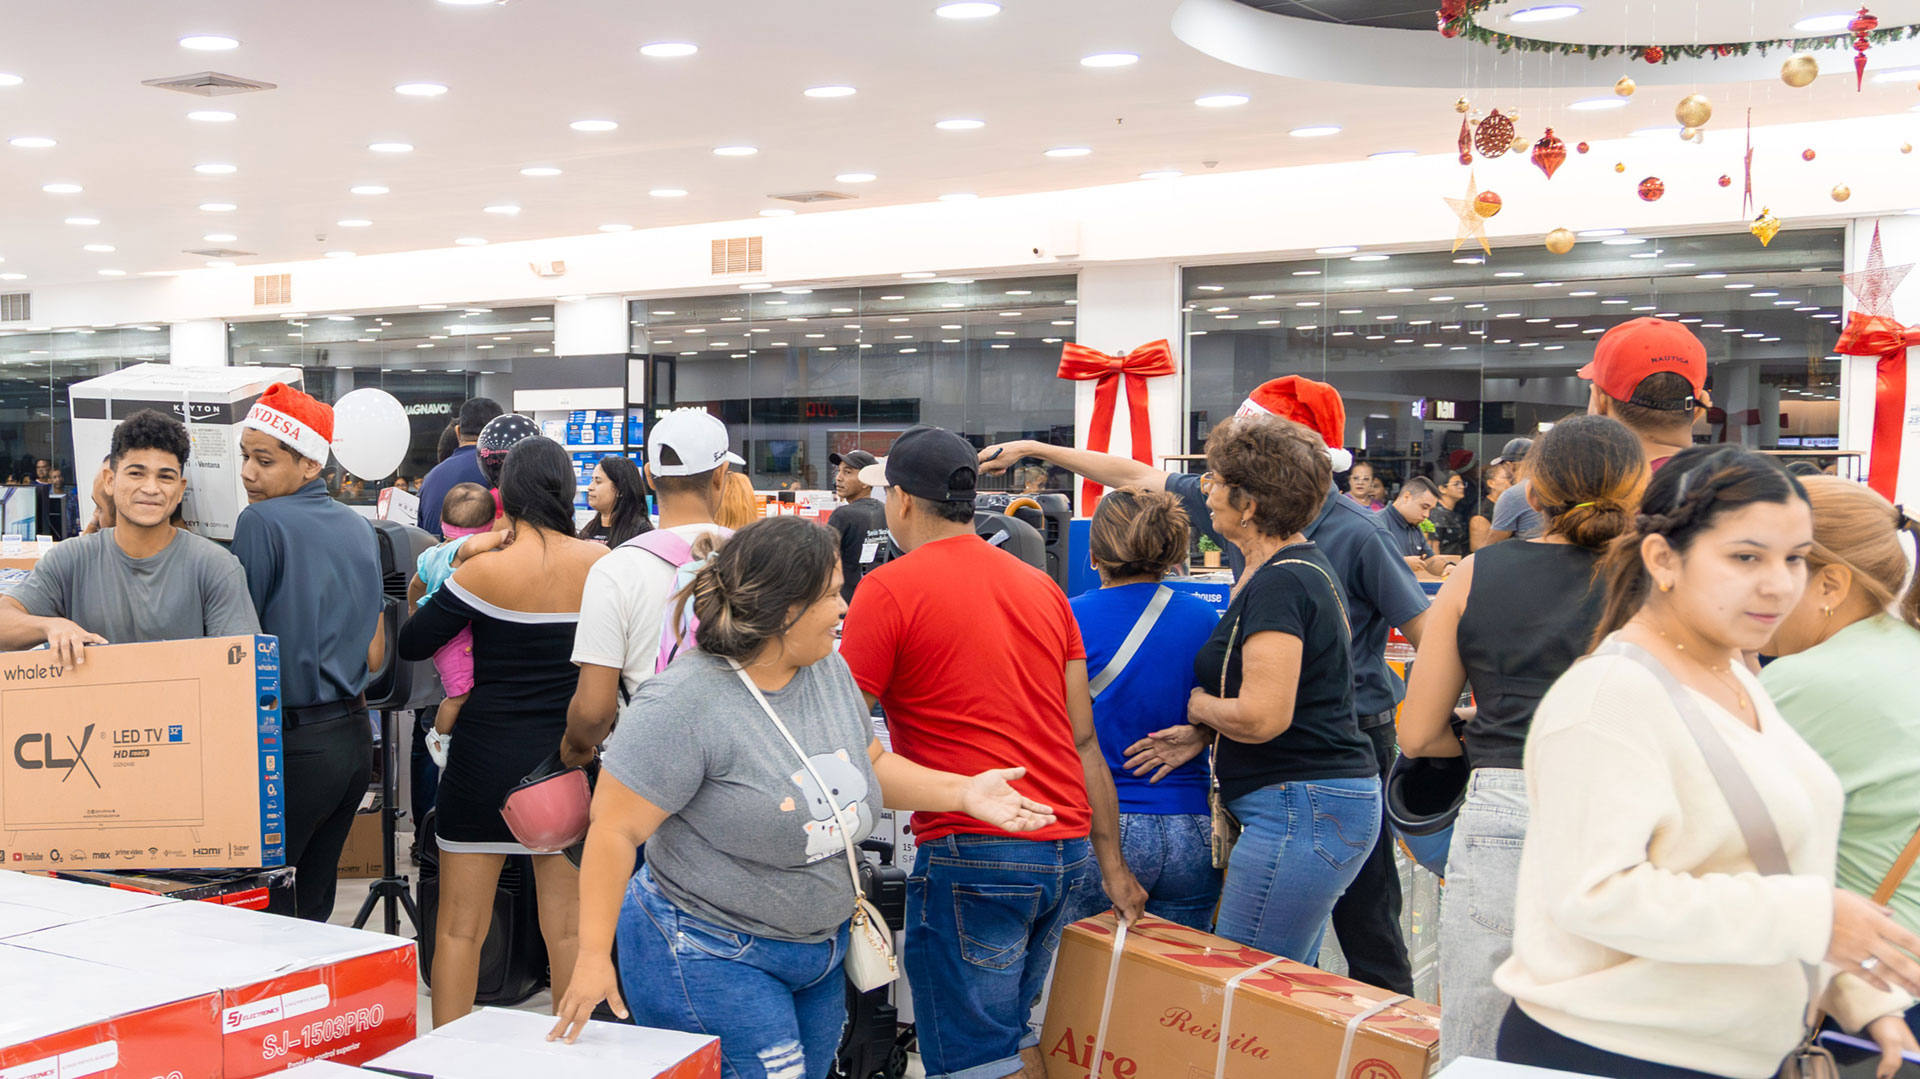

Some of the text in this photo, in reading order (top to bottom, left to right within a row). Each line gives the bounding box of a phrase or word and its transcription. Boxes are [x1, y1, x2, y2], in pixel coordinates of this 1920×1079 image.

[1651, 355, 1688, 365] NAUTICA
[198, 460, 220, 468] Ventana
[4, 664, 64, 681] whale tv
[113, 729, 140, 744] LED
[144, 728, 163, 742] TV
[14, 723, 101, 788] CLX
[113, 749, 128, 758] HD
[23, 852, 43, 861] YouTube
[193, 847, 221, 855] HDMI
[242, 1007, 280, 1022] ELECTRONICS
[262, 1003, 384, 1060] SJ-1503PRO
[336, 1042, 361, 1056] superior
[1049, 1027, 1138, 1079] Aire
